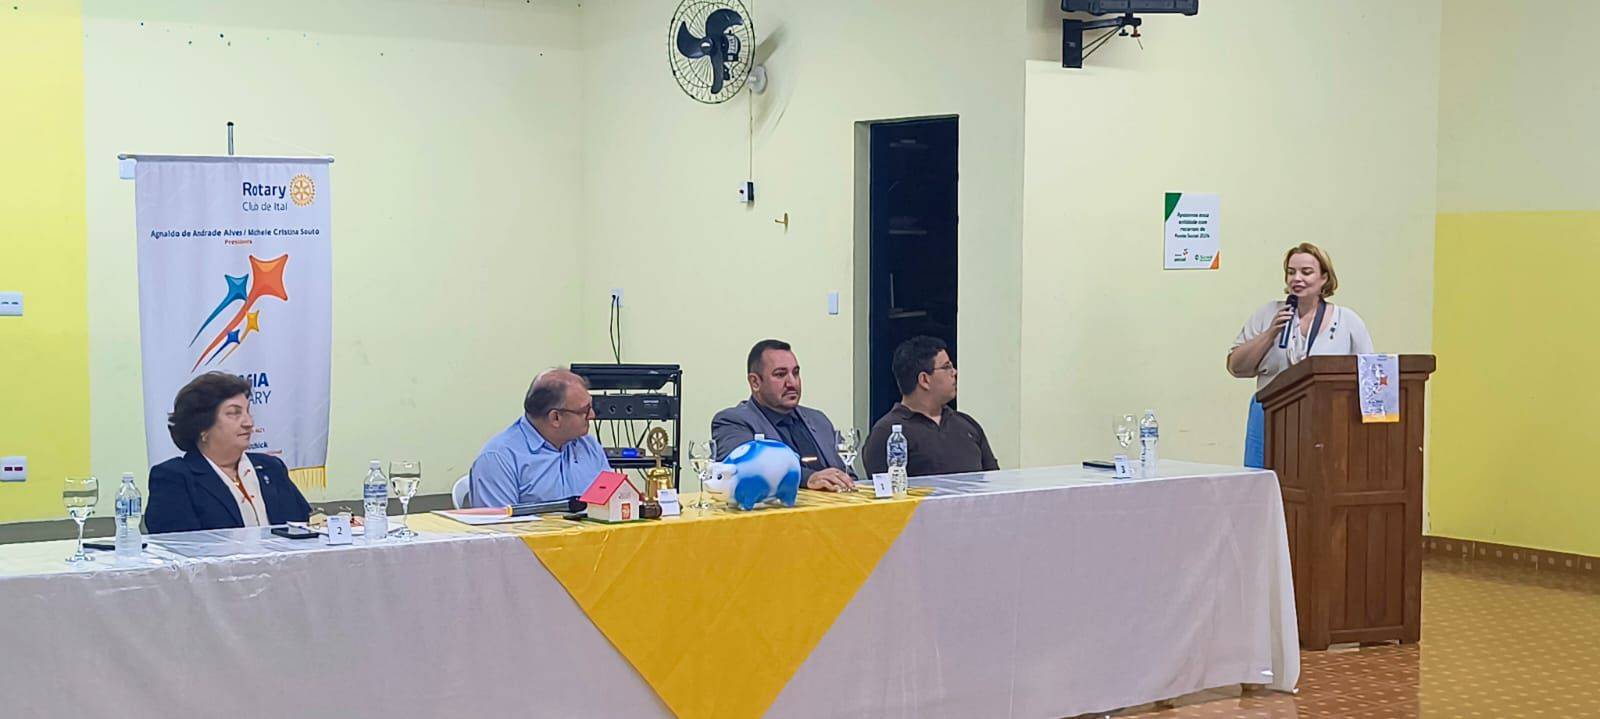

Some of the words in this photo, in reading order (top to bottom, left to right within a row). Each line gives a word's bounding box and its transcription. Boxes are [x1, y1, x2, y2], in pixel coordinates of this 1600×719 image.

[242, 181, 286, 199] Rotary
[261, 201, 271, 211] de
[150, 230, 180, 240] Agnaldo
[181, 230, 191, 238] de
[193, 229, 221, 237] Andrade
[223, 229, 243, 237] Alves
[336, 526, 343, 535] 2
